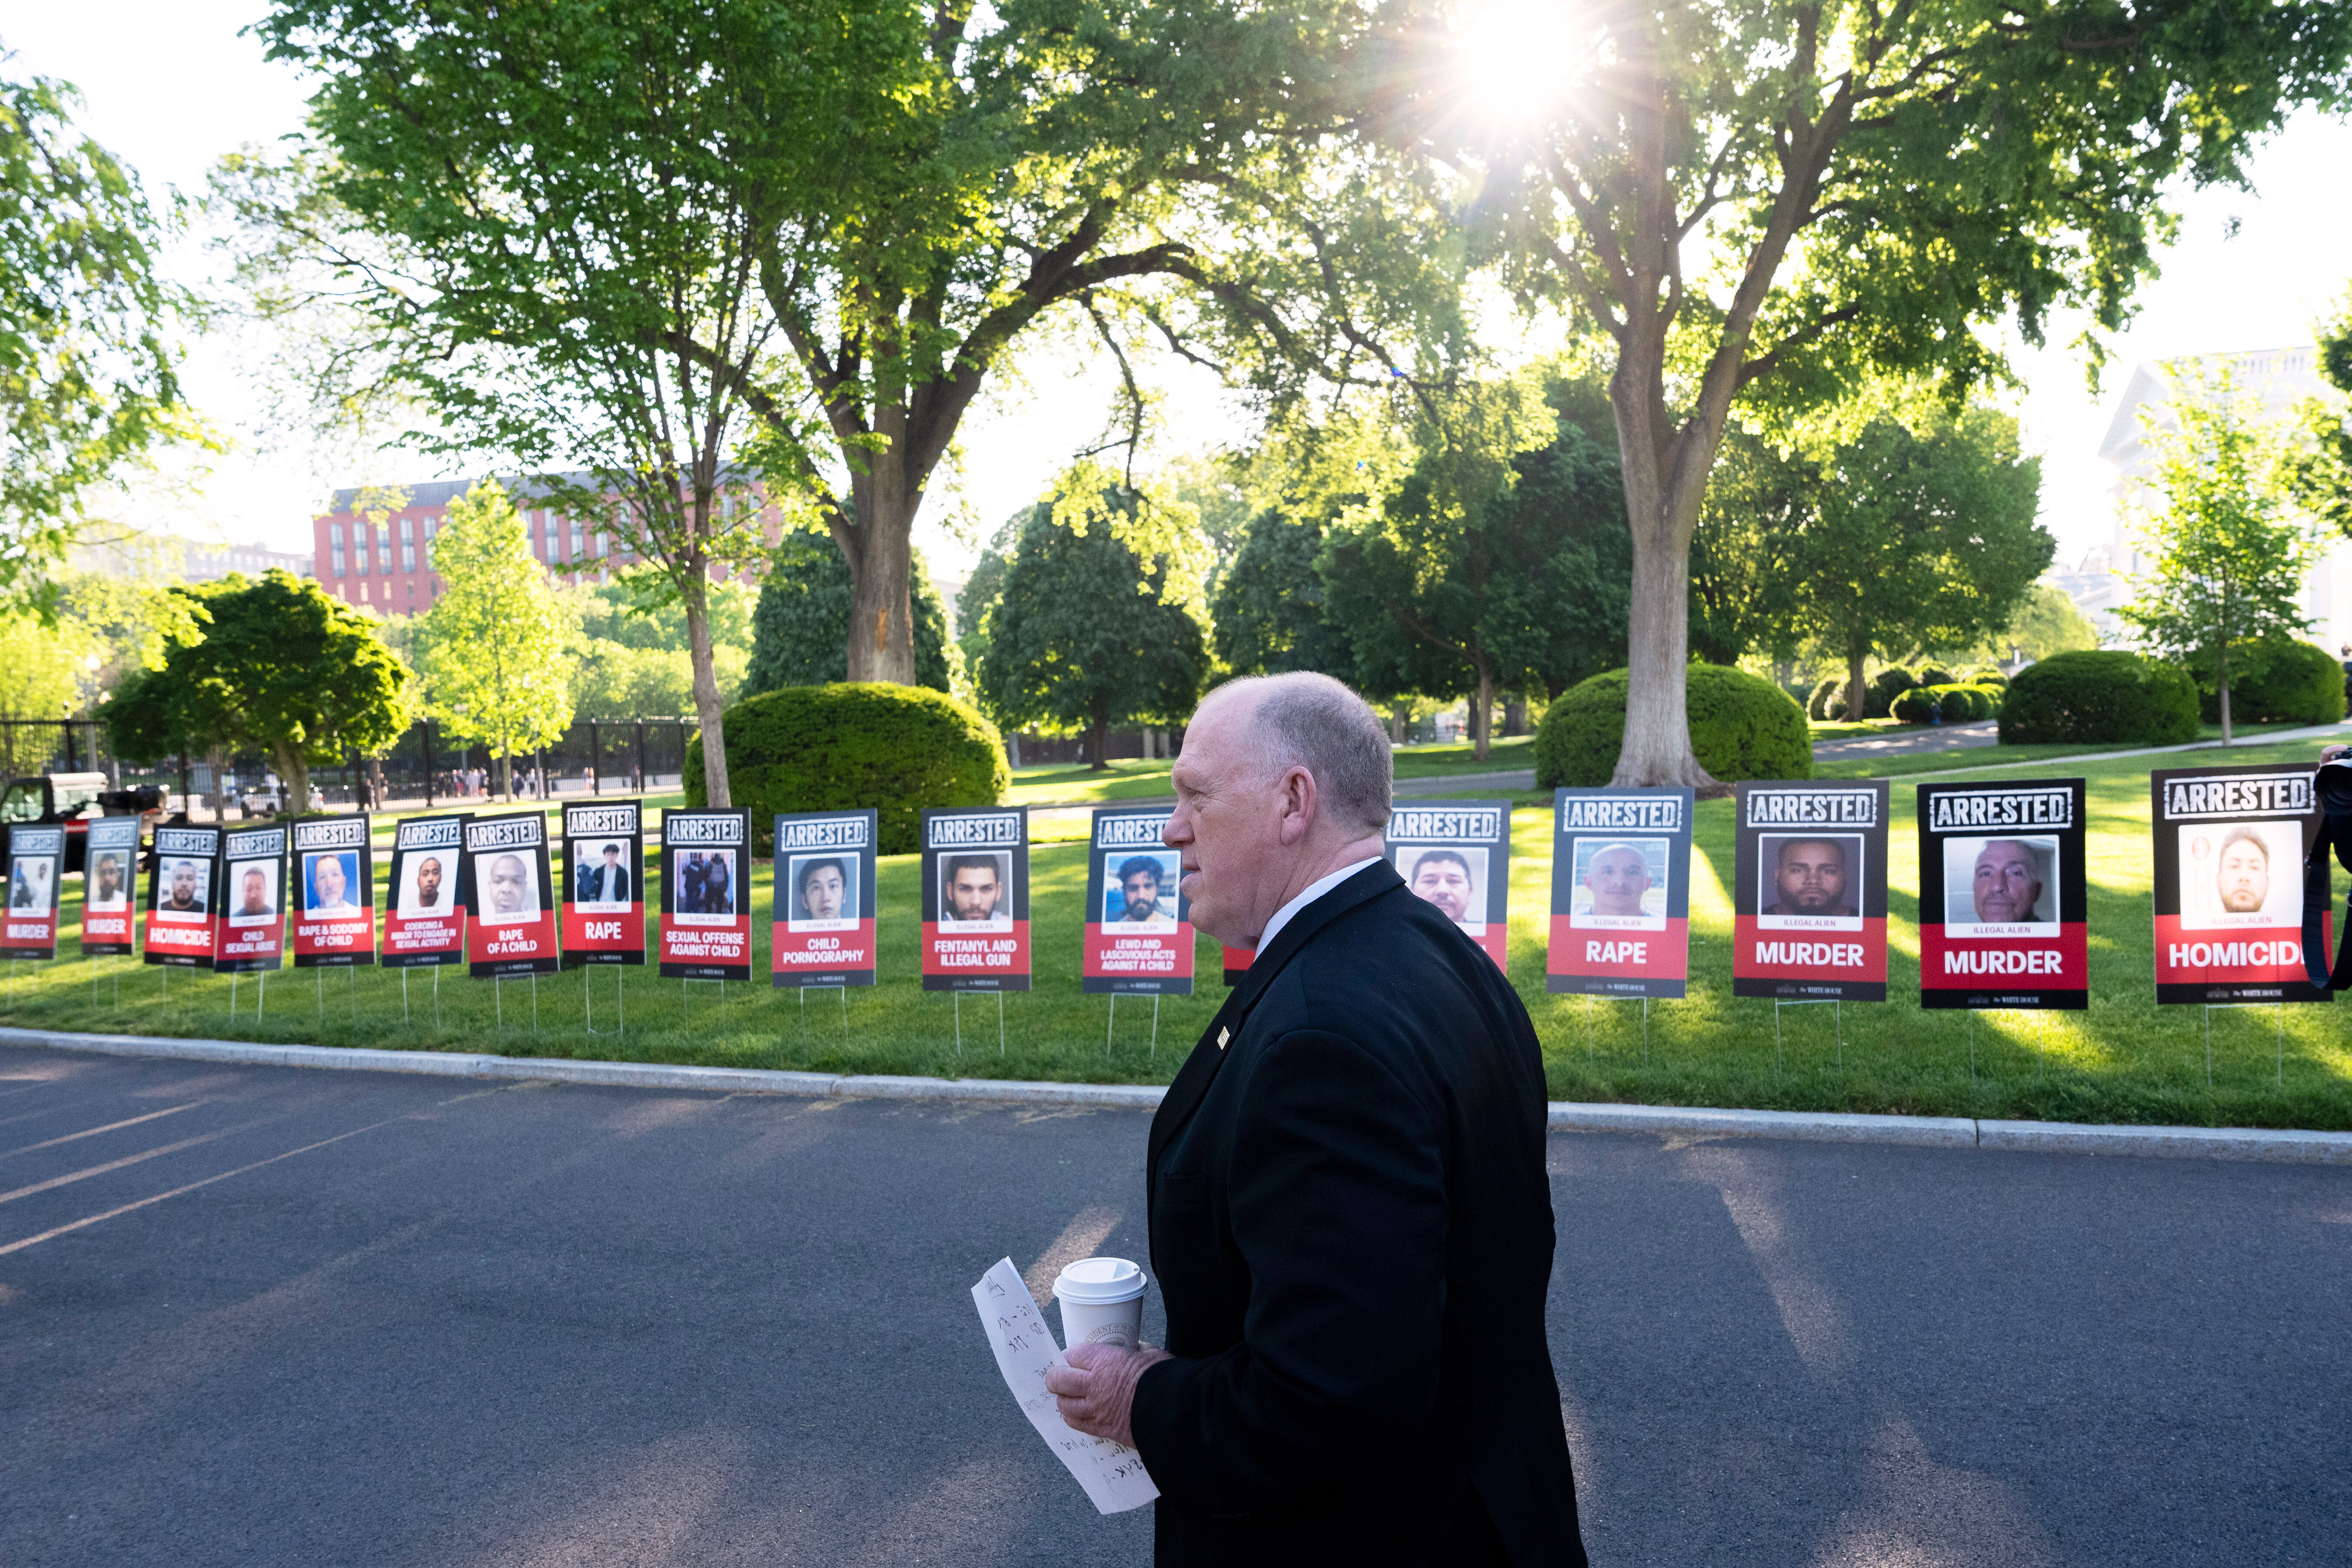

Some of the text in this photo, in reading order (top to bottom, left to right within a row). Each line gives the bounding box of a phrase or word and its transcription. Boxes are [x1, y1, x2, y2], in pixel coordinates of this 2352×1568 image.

[2172, 779, 2308, 813] ARRESTED
[1570, 802, 1676, 827] ARRESTED
[1753, 794, 1870, 822] ARRESTED
[1938, 794, 2065, 826] ARRESTED
[570, 810, 633, 832] ARRESTED
[670, 819, 739, 840] ARRESTED
[1392, 812, 1494, 838] ARRESTED
[298, 822, 361, 846] ARRESTED
[470, 821, 537, 848] ARRESTED
[786, 821, 865, 847] ARRESTED
[933, 819, 1016, 843] ARRESTED
[1102, 819, 1169, 843] ARREST
[160, 832, 215, 852] ARRESTED
[229, 832, 281, 854] ARRESTED
[298, 922, 368, 936] RAPE & SODOMY
[413, 930, 422, 939] TO
[422, 929, 448, 938] ENGAGE
[449, 928, 457, 937] IN
[437, 920, 443, 929] A
[585, 922, 622, 940] RAPE
[149, 927, 211, 946] HOMICIDE
[242, 931, 265, 942] CHILD
[314, 935, 353, 947] OF CHILD
[395, 938, 451, 949] SEXUAL ACTIVITY
[499, 929, 524, 941] RAPE
[666, 931, 745, 945] SEXUAL OFFENSE
[807, 937, 840, 950] CHILD
[225, 942, 255, 954] SEXUAL
[487, 940, 538, 955] OF A CHILD
[669, 943, 740, 957] AGAINST CHILD
[934, 939, 1017, 953] FENTANYL AND
[1115, 939, 1162, 950] LEWD AND
[1586, 940, 1647, 964] RAPE
[783, 949, 864, 964] PORNOGRAPHY
[941, 953, 1011, 966] ILLEGAL GUN
[1100, 949, 1176, 960] LASCIVIOUS ACTS
[1756, 941, 1864, 967] MURDER
[1945, 950, 2063, 974] MURDER
[2170, 941, 2305, 967] HOMICID
[1101, 960, 1174, 971] AGAINST A CHILD
